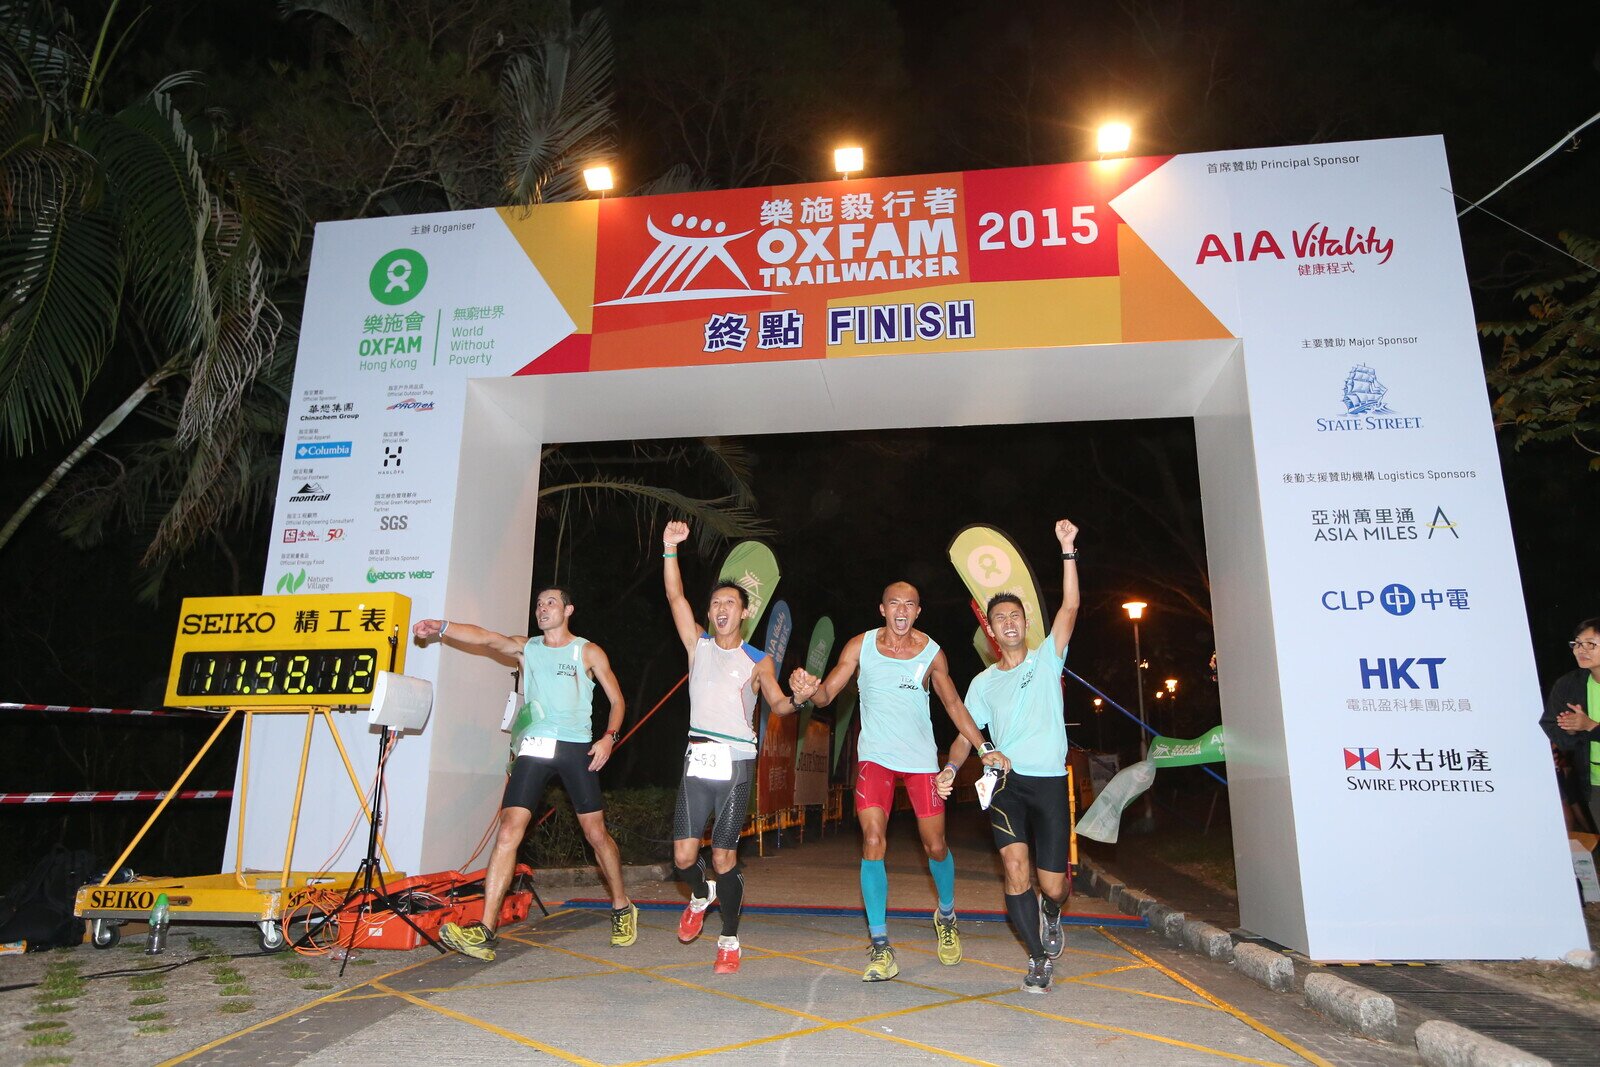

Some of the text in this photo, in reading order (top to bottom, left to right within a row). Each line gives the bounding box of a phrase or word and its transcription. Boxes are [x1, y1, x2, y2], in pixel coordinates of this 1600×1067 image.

[1261, 157, 1310, 170] Principal
[1313, 155, 1360, 168] Sponsor
[760, 186, 958, 227] 樂施毅行者
[433, 222, 476, 235] Organiser
[978, 205, 1099, 251] 2015
[757, 218, 958, 265] OXFAM
[1196, 221, 1394, 265] AIA Vitality
[759, 256, 960, 288] TRAILWALKER
[1298, 261, 1355, 277] 健康程式
[452, 304, 505, 321] 無窮世界
[362, 310, 426, 335] 樂施會
[703, 299, 976, 353] 終點 FINISH
[451, 325, 484, 338] World
[358, 335, 423, 357] OXFAM
[450, 338, 496, 352] Without
[1348, 338, 1376, 348] Major
[1377, 336, 1419, 347] Sponsor
[359, 358, 418, 373] Hong Kong
[449, 353, 492, 366] Poverty
[1316, 416, 1423, 432] STATE STREET
[308, 445, 350, 456] Columbia
[1377, 470, 1425, 482] Logistics
[1427, 469, 1477, 481] Sponsors
[289, 493, 331, 503] montrail
[380, 515, 409, 531] SGS
[1311, 507, 1416, 526] 亞洲萬里通
[1314, 525, 1418, 542] ASIA MILES
[307, 583, 330, 591] Village
[1321, 590, 1375, 611] CLP
[1420, 588, 1471, 611] 中電
[181, 608, 387, 635] SEIKO 精工表
[1358, 657, 1447, 690] HKT
[1346, 698, 1473, 713] 電訊盈科集團成員
[1386, 748, 1492, 772] 太古地產
[1346, 776, 1495, 793] SWIRE PROPERTIES
[90, 890, 154, 910] SEIKO
